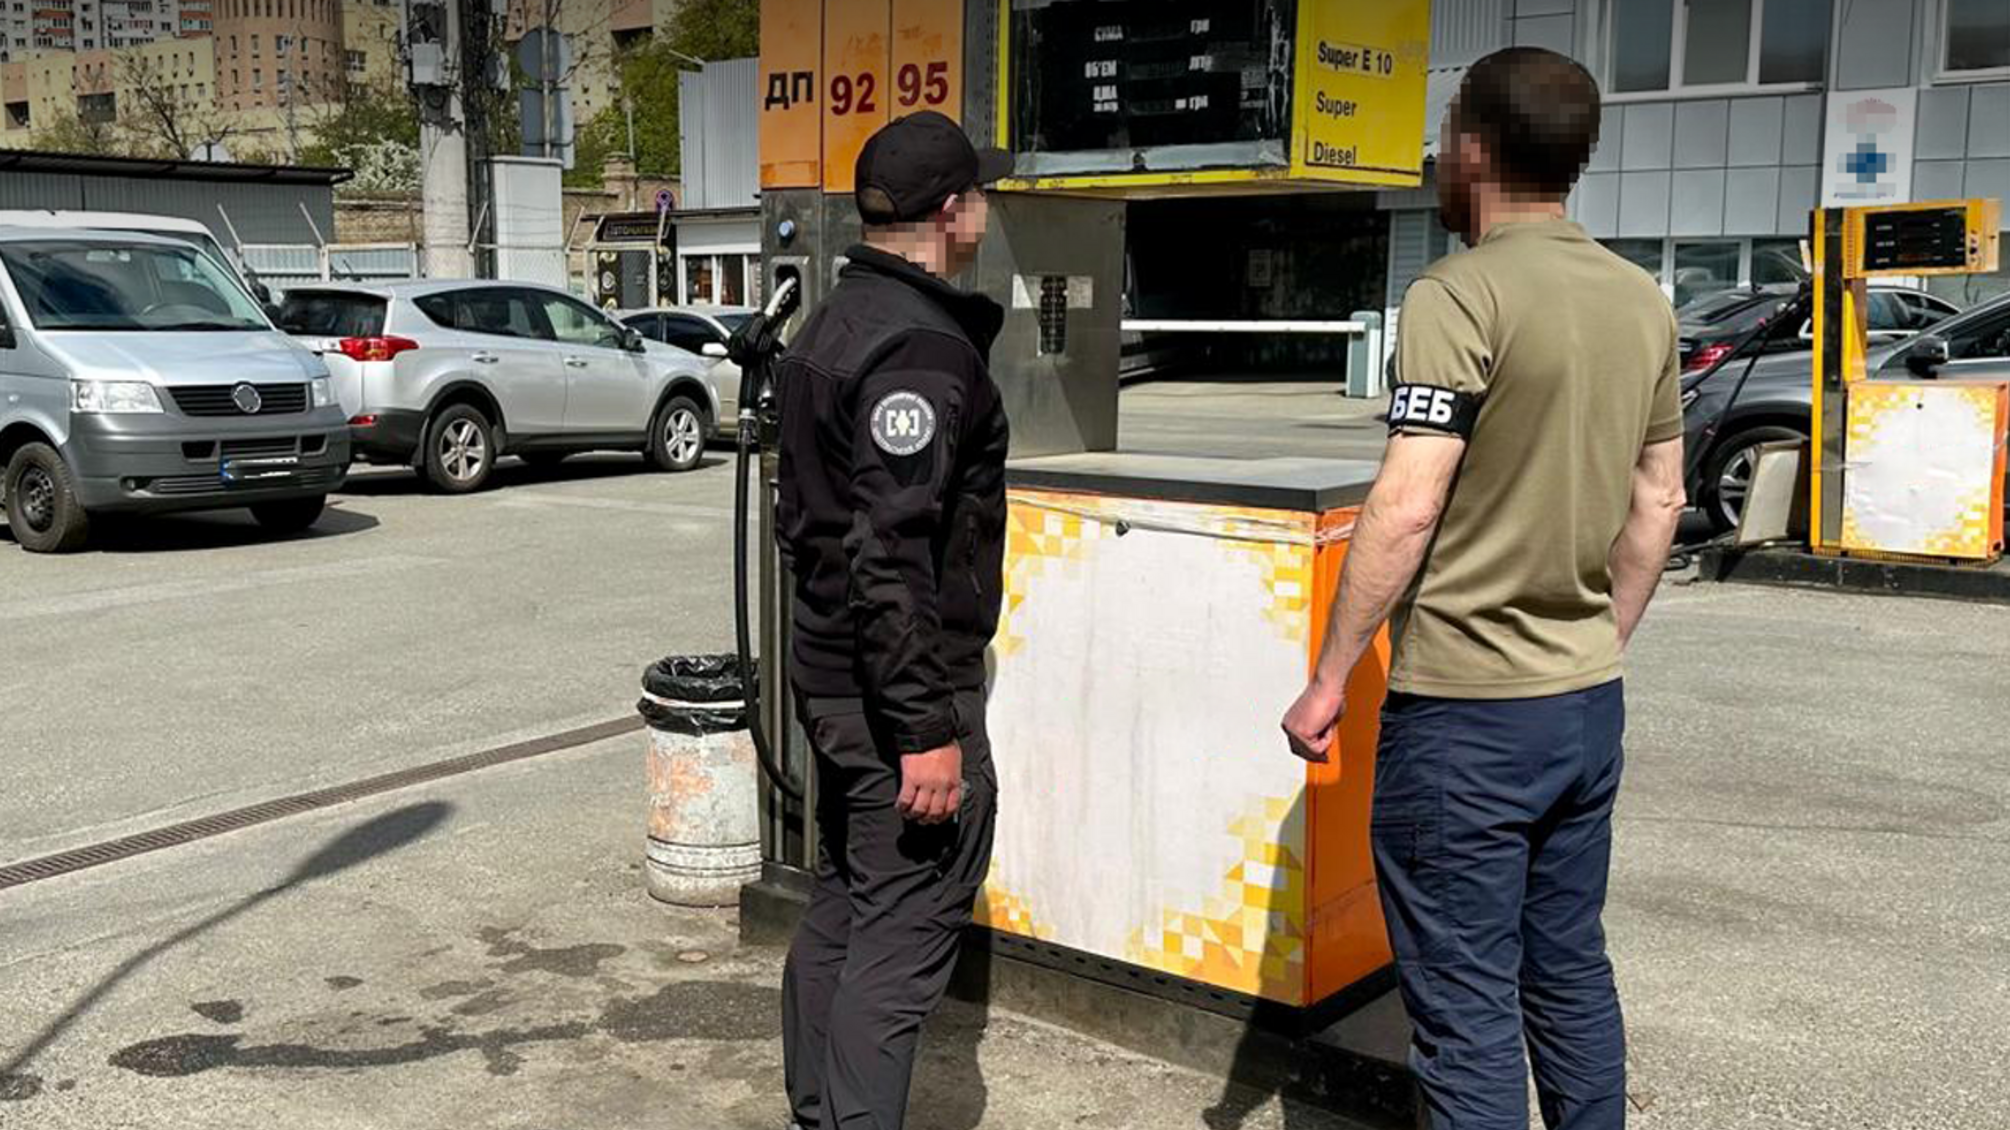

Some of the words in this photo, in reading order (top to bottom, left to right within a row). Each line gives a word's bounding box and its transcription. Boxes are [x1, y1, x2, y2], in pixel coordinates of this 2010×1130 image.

[1094, 24, 1123, 42] СУМА
[1318, 41, 1358, 71] Super
[1362, 48, 1372, 71] E
[1376, 53, 1392, 75] 10
[764, 70, 814, 111] ДП
[830, 72, 876, 116] 92
[897, 61, 949, 106] 95
[1315, 90, 1358, 120] Super
[1313, 140, 1357, 165] Diesel
[1390, 385, 1456, 424] БЕБ
